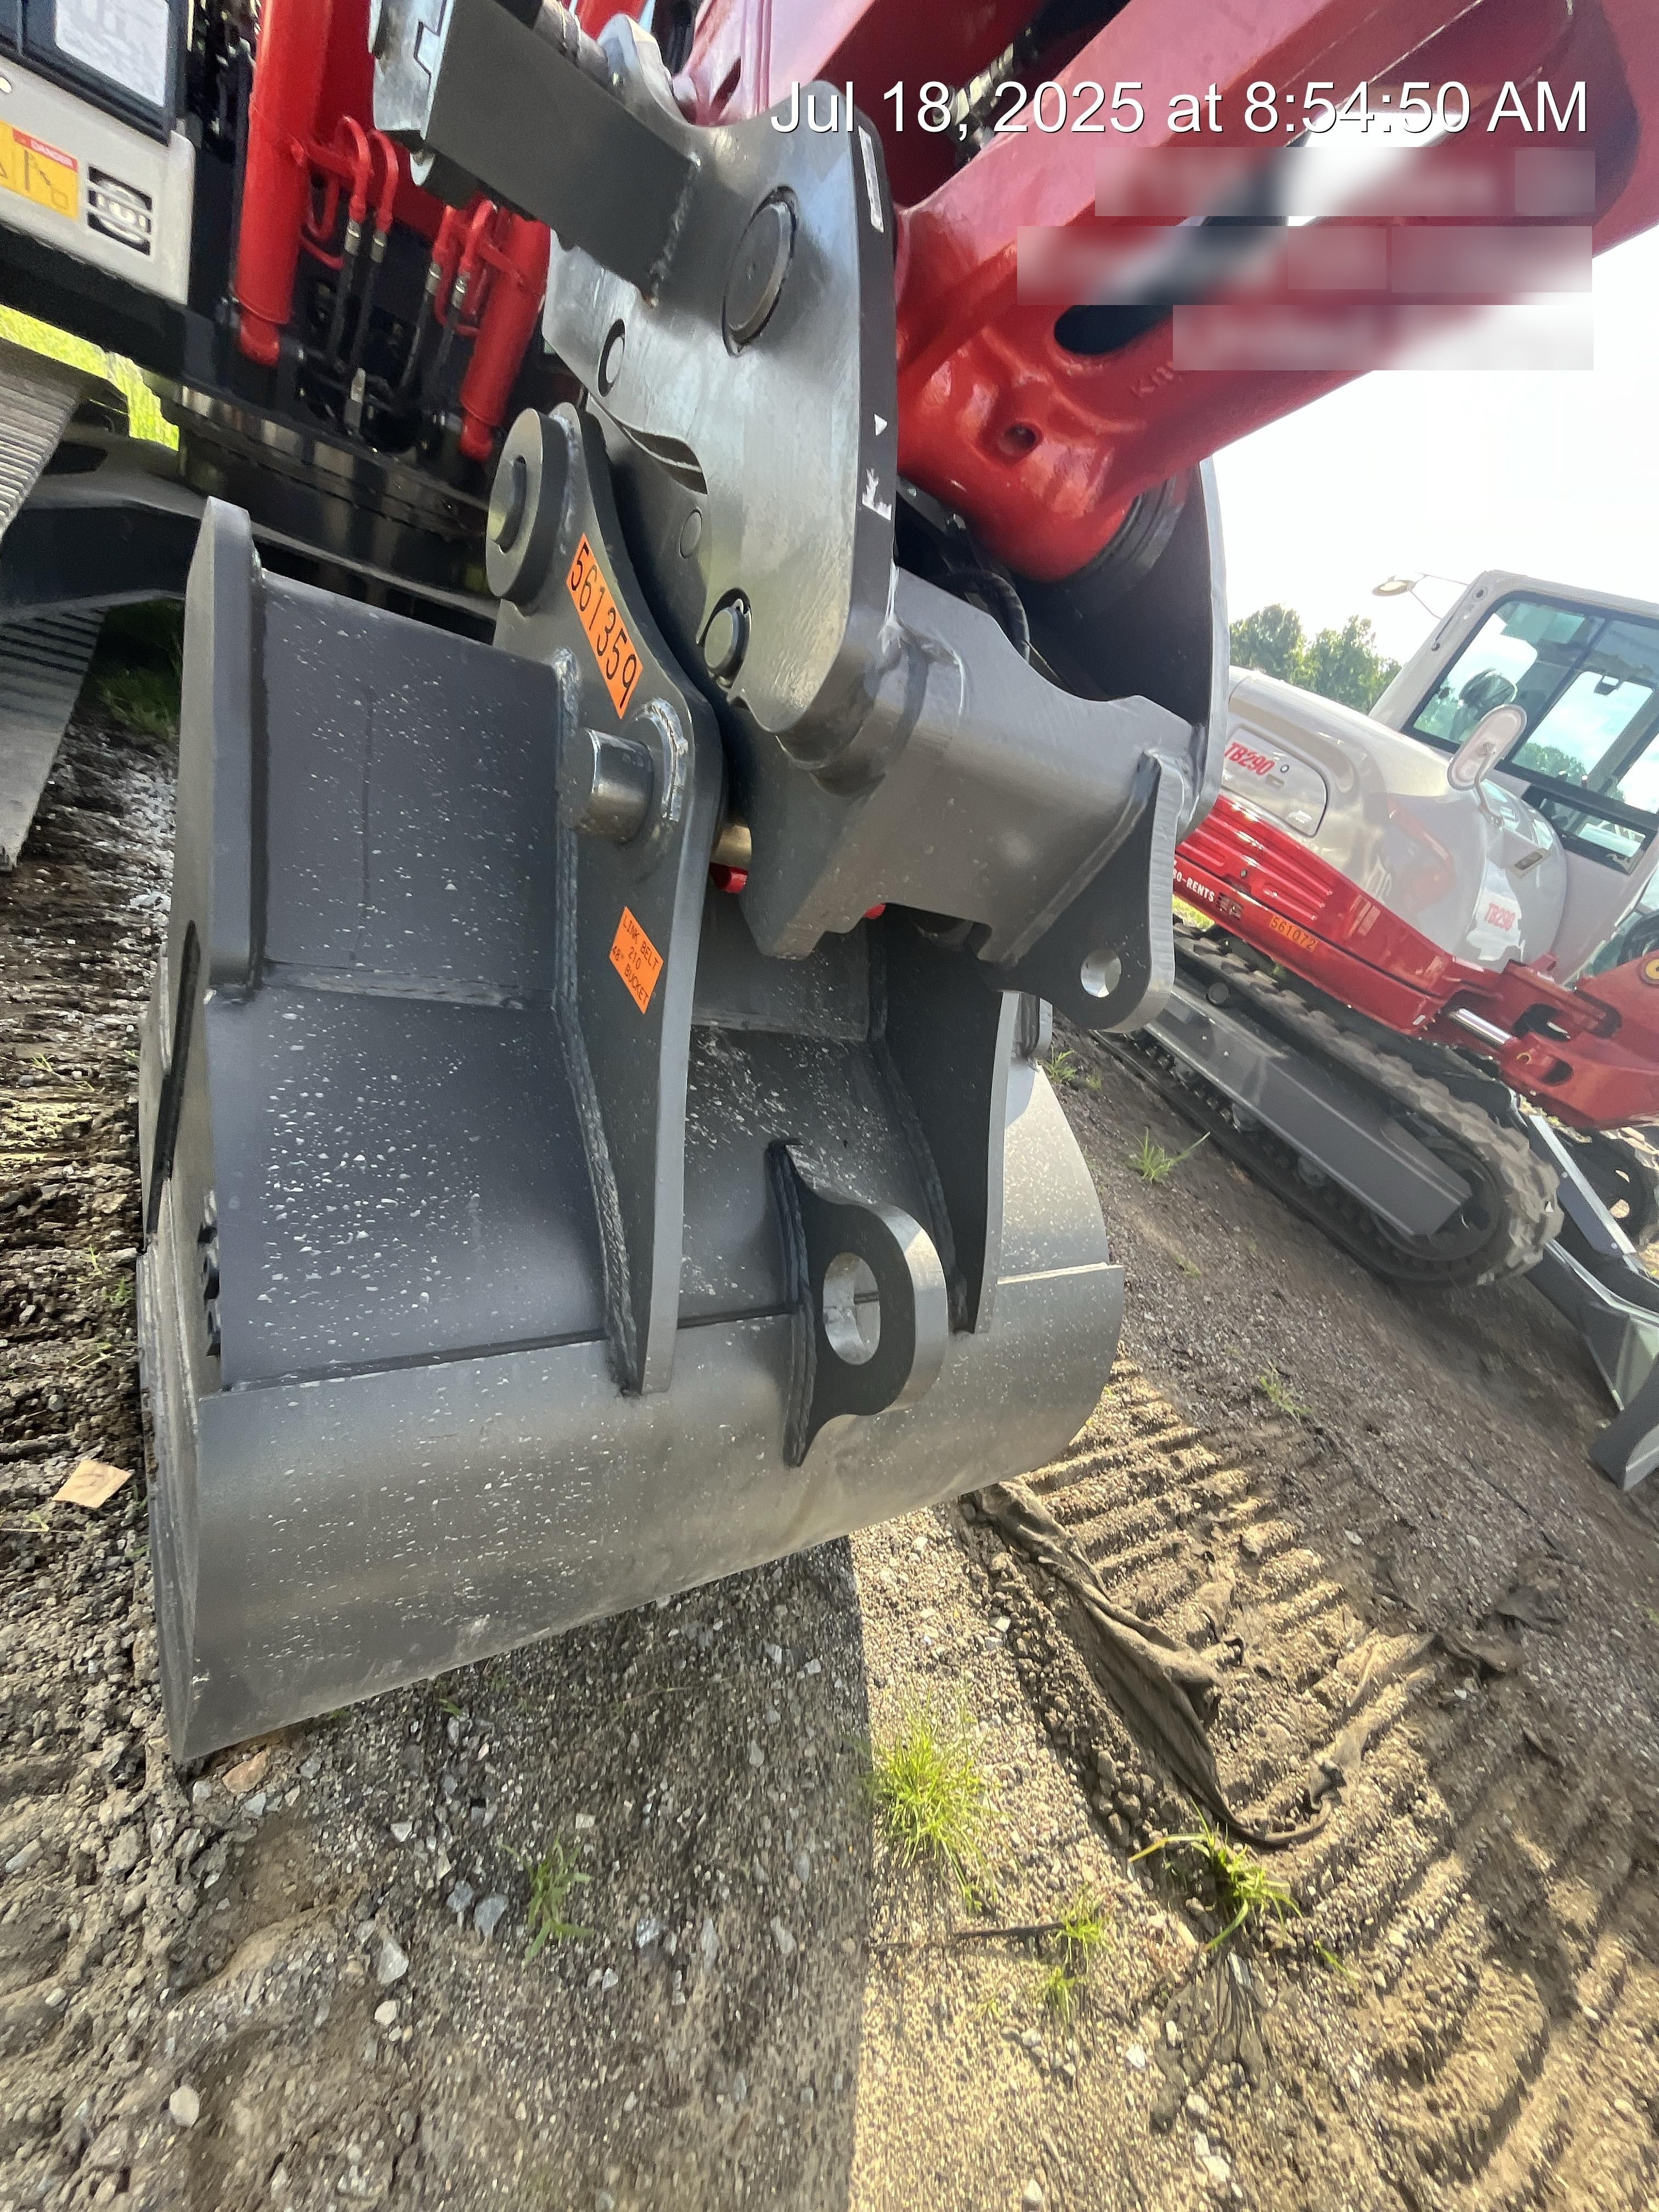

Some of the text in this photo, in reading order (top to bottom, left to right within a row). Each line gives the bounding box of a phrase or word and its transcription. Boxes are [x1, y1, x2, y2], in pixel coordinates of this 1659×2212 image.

[571, 541, 637, 710] 561359
[1224, 741, 1276, 776] TB290
[623, 915, 659, 970] LINK BELT
[1271, 916, 1316, 951] 561072
[628, 946, 641, 970] 210
[624, 963, 649, 1006] BUCKET
